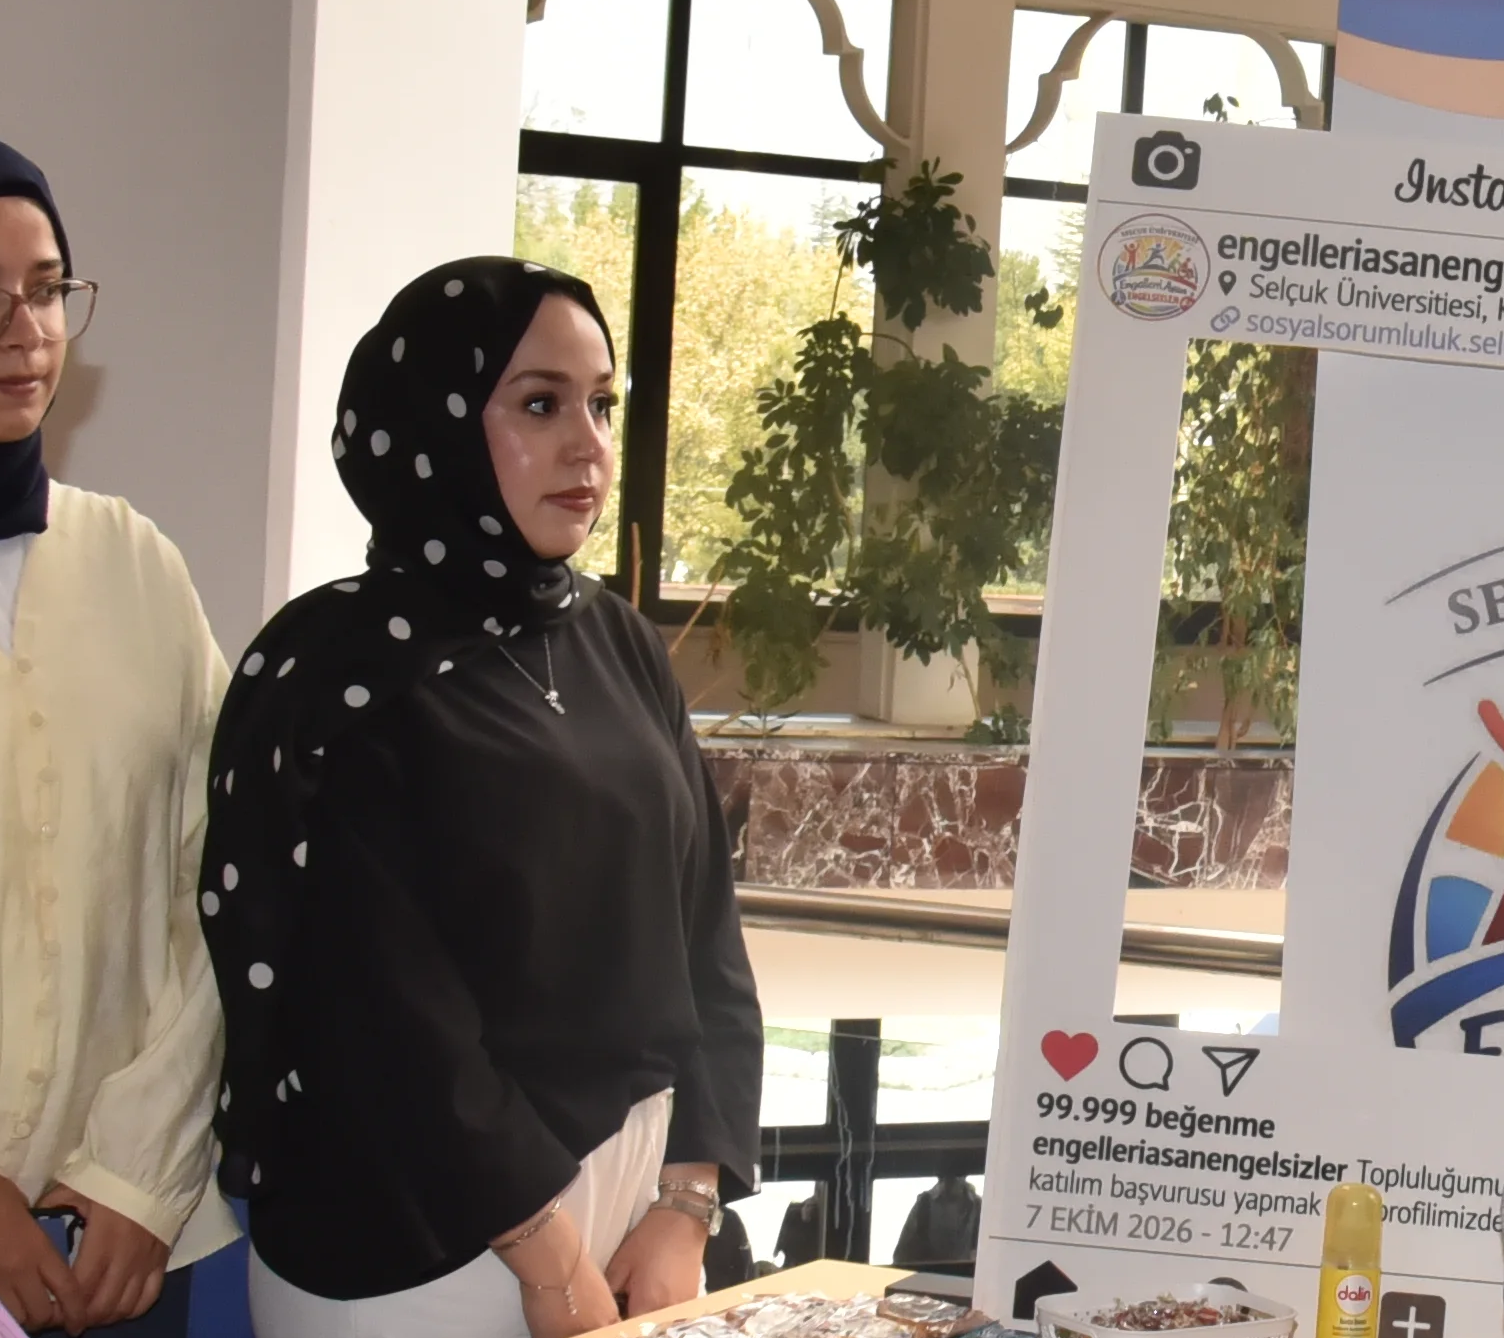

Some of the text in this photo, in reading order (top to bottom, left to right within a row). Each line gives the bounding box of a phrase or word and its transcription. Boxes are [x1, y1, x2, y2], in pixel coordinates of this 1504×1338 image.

[1249, 269, 1329, 307] Selçuk
[1036, 1092, 1276, 1139] 99.999 beğenme
[1032, 1135, 1349, 1182] engelleriasanengelsizler
[1029, 1166, 1103, 1197] katılım
[1110, 1172, 1226, 1208] başvurusu
[1233, 1191, 1322, 1218] yapmak
[1026, 1204, 1043, 1229] 7
[1050, 1205, 1119, 1237] EKİM
[1127, 1213, 1193, 1244] 2026
[1220, 1222, 1294, 1252] 12:47
